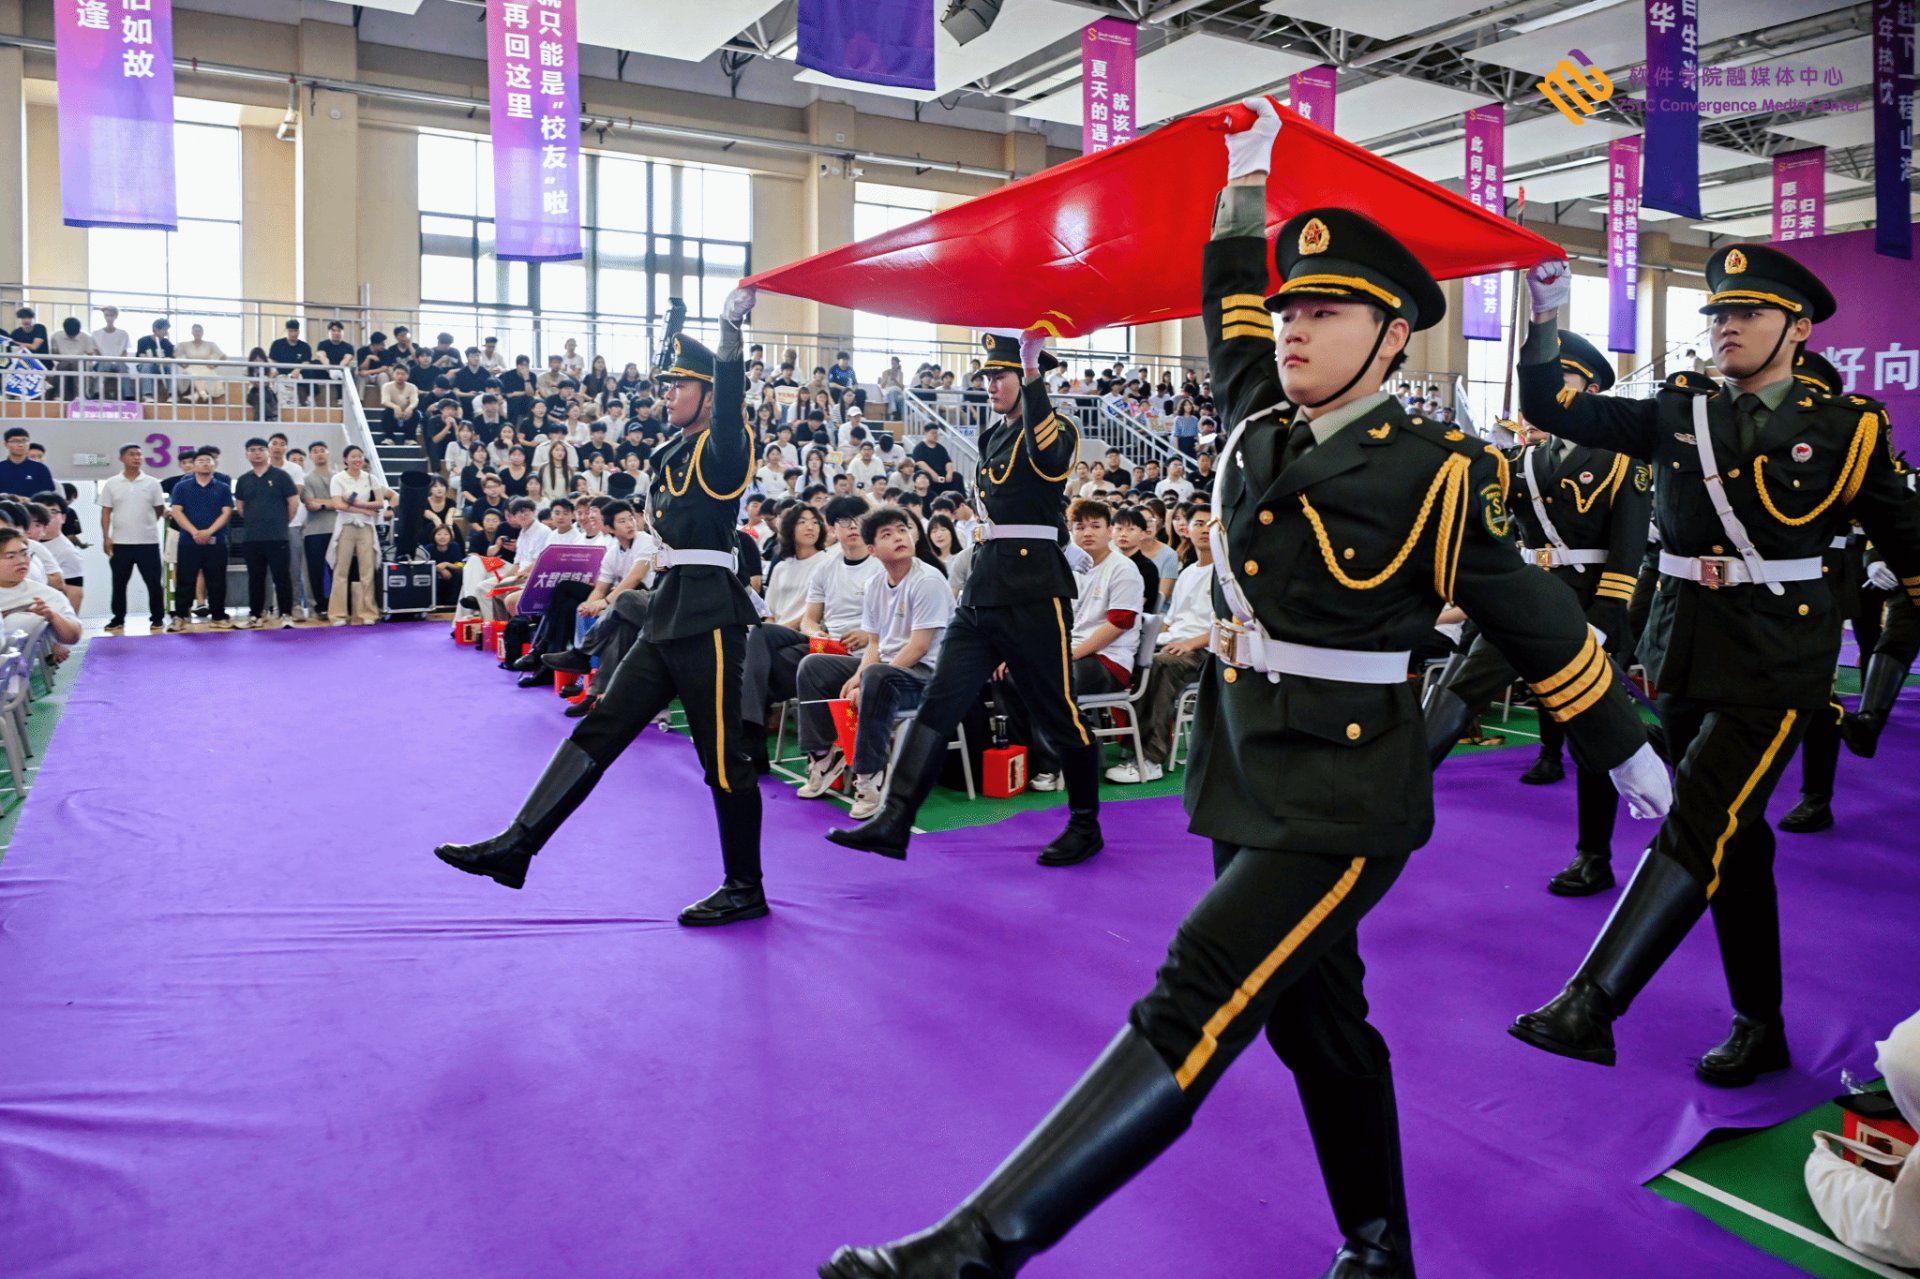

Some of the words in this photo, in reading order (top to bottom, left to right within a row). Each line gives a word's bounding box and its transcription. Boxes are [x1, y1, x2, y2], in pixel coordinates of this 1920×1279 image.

[503, 2, 534, 119] 再回这里
[1878, 0, 1895, 106] 年热忱
